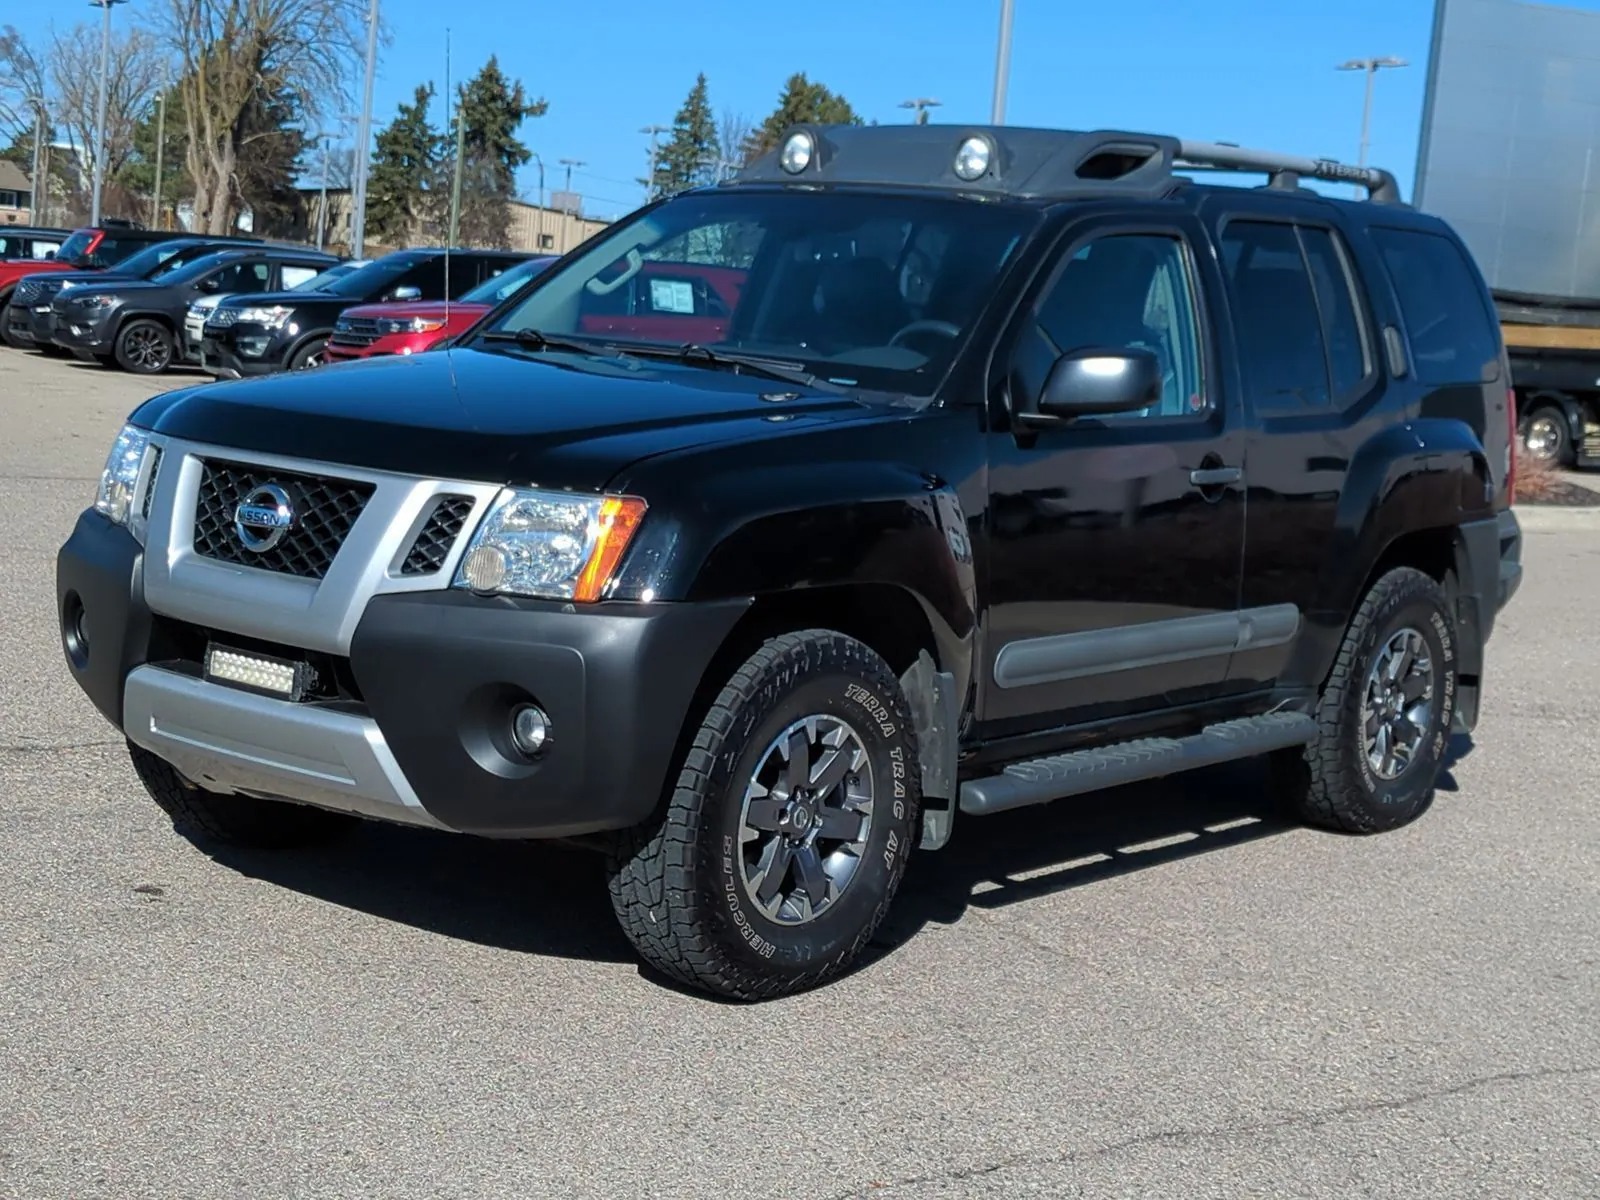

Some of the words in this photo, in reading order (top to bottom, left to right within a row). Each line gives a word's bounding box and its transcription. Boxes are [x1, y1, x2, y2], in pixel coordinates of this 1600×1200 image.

[237, 508, 280, 526] SSAN
[844, 683, 897, 739] TERRA
[890, 746, 906, 821] TRAC
[883, 829, 899, 871] AT
[722, 834, 777, 959] HERCULES
